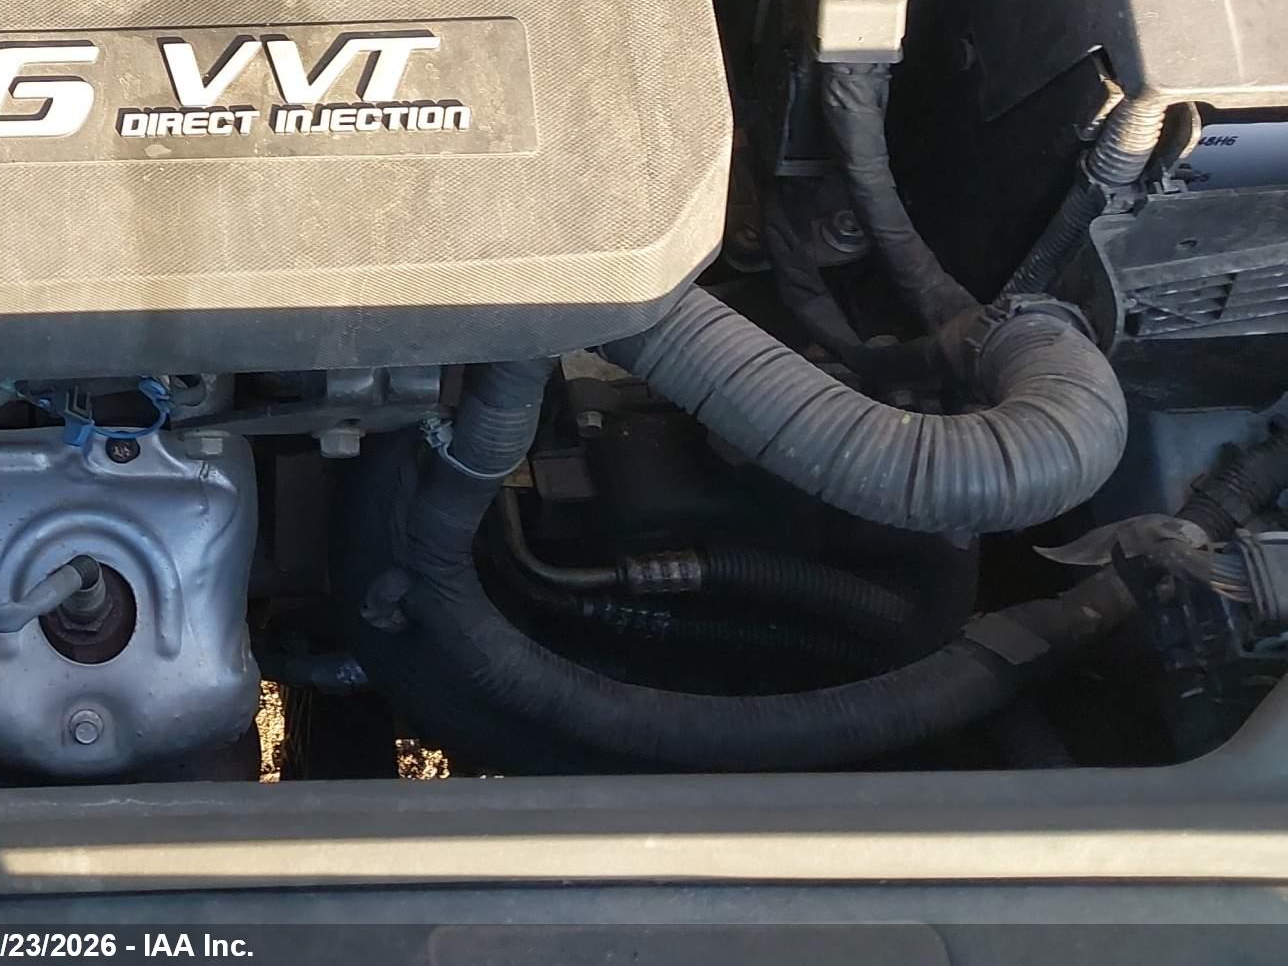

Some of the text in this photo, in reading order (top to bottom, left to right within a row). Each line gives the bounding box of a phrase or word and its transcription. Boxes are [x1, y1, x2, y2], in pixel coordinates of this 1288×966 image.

[159, 32, 440, 106] VVT
[116, 100, 470, 136] DIRECT INJECTION
